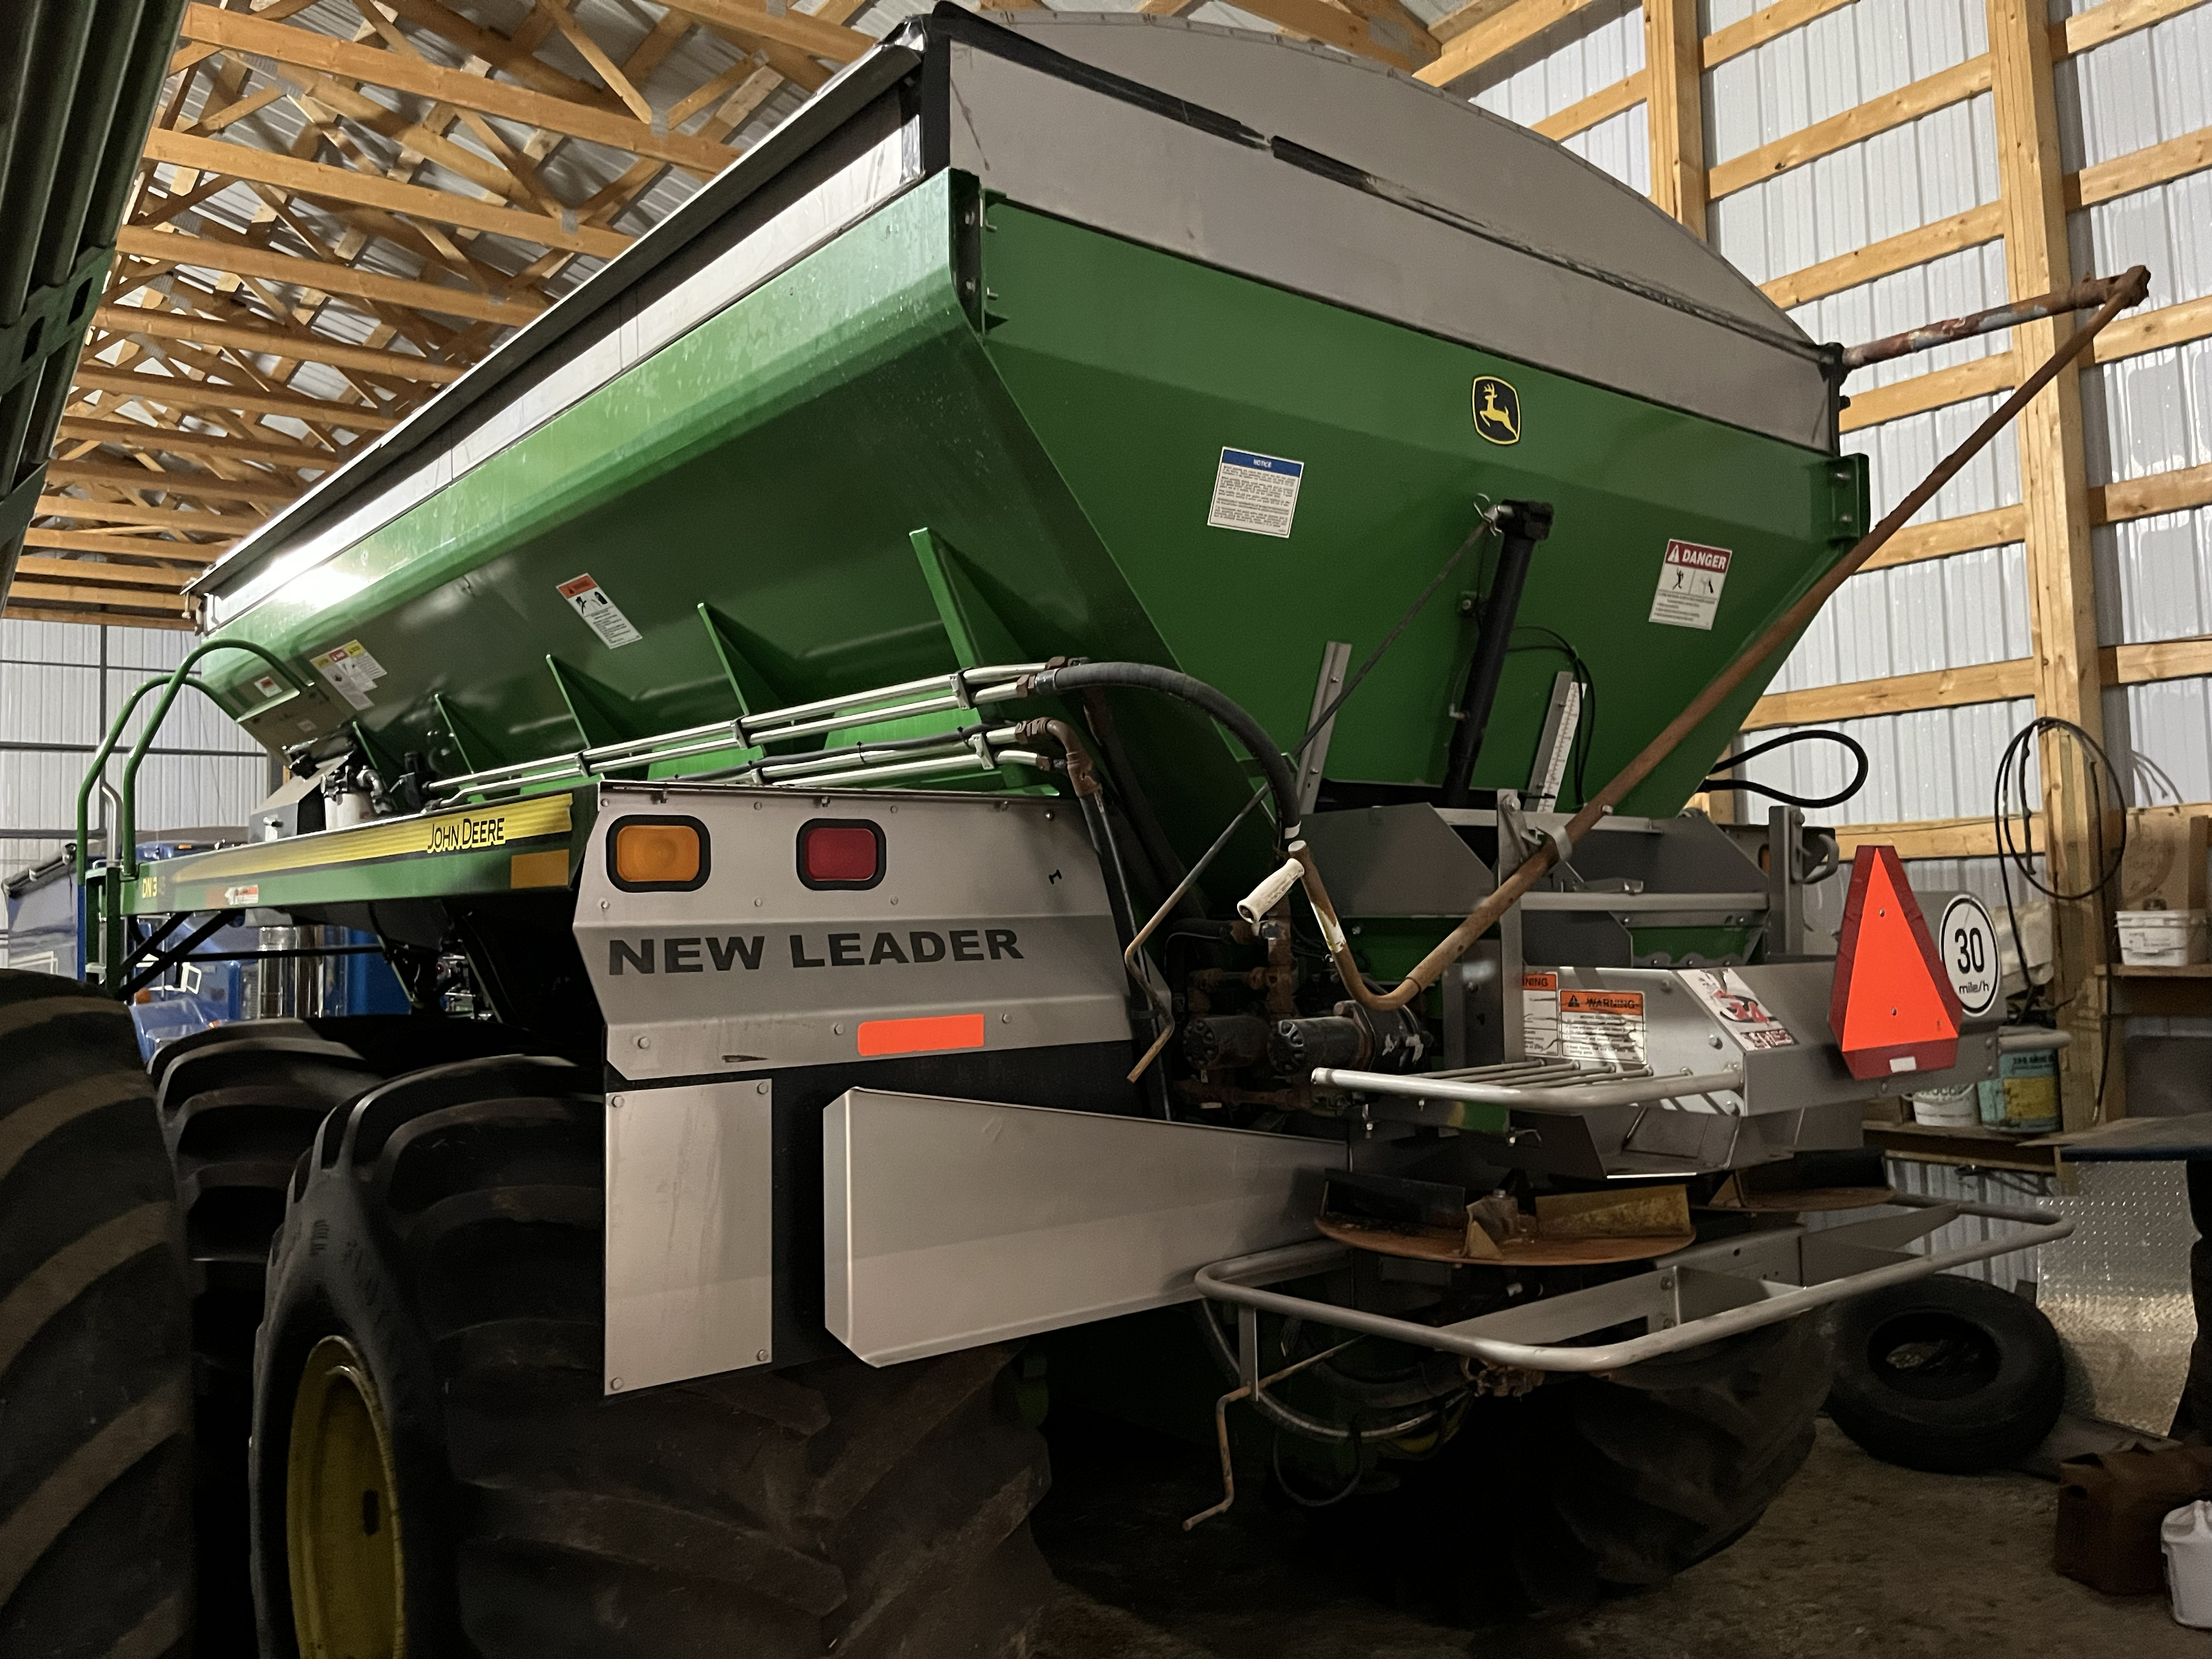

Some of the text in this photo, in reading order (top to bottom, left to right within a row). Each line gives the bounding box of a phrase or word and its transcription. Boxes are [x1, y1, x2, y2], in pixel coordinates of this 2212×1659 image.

[1253, 459, 1272, 469] NOTICE
[1681, 549, 1726, 570] DANGER
[427, 817, 505, 850] JOHN DEERE
[609, 929, 1024, 976] NEW LEADER
[1955, 927, 1985, 974] 30
[1959, 981, 1990, 995] mile/h
[1587, 998, 1635, 1009] WARNING
